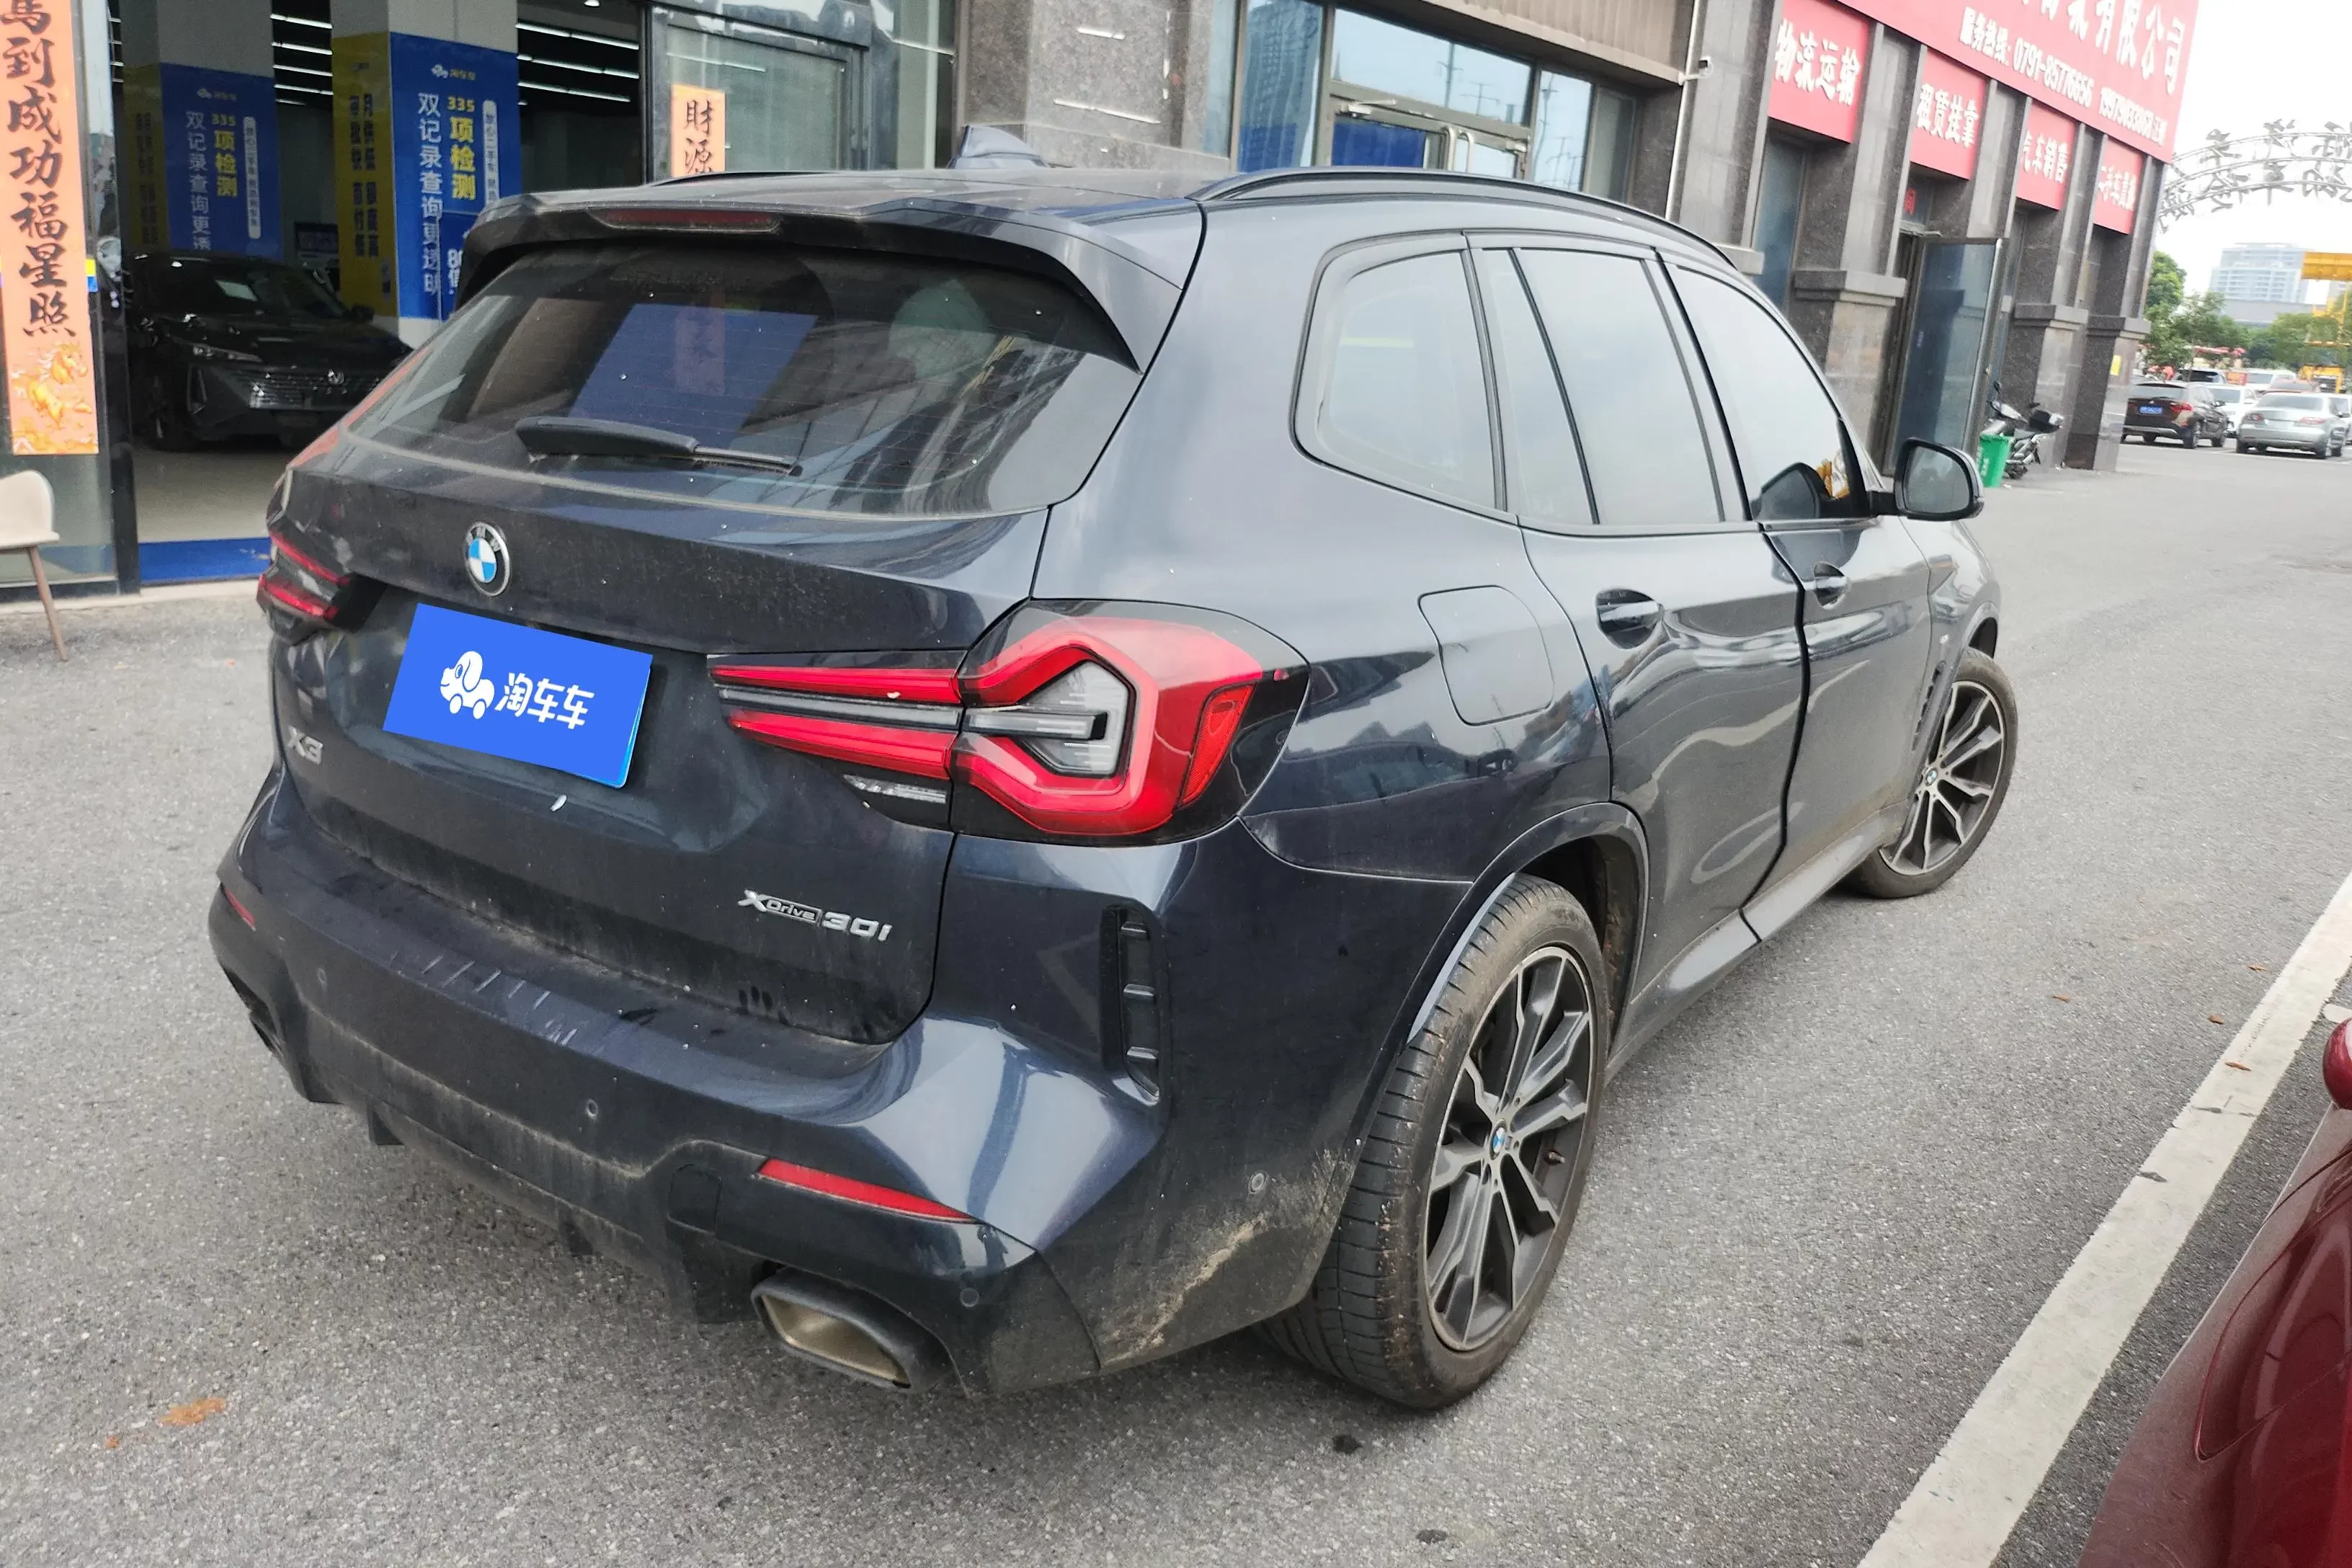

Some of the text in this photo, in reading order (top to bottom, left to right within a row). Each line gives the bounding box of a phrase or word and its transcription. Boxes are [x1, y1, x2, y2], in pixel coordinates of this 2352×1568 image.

[1774, 17, 1861, 106] 物流运输
[1916, 83, 1979, 148] 租赁挂靠
[2020, 128, 2070, 185] 汽车销售
[288, 726, 324, 765] X3
